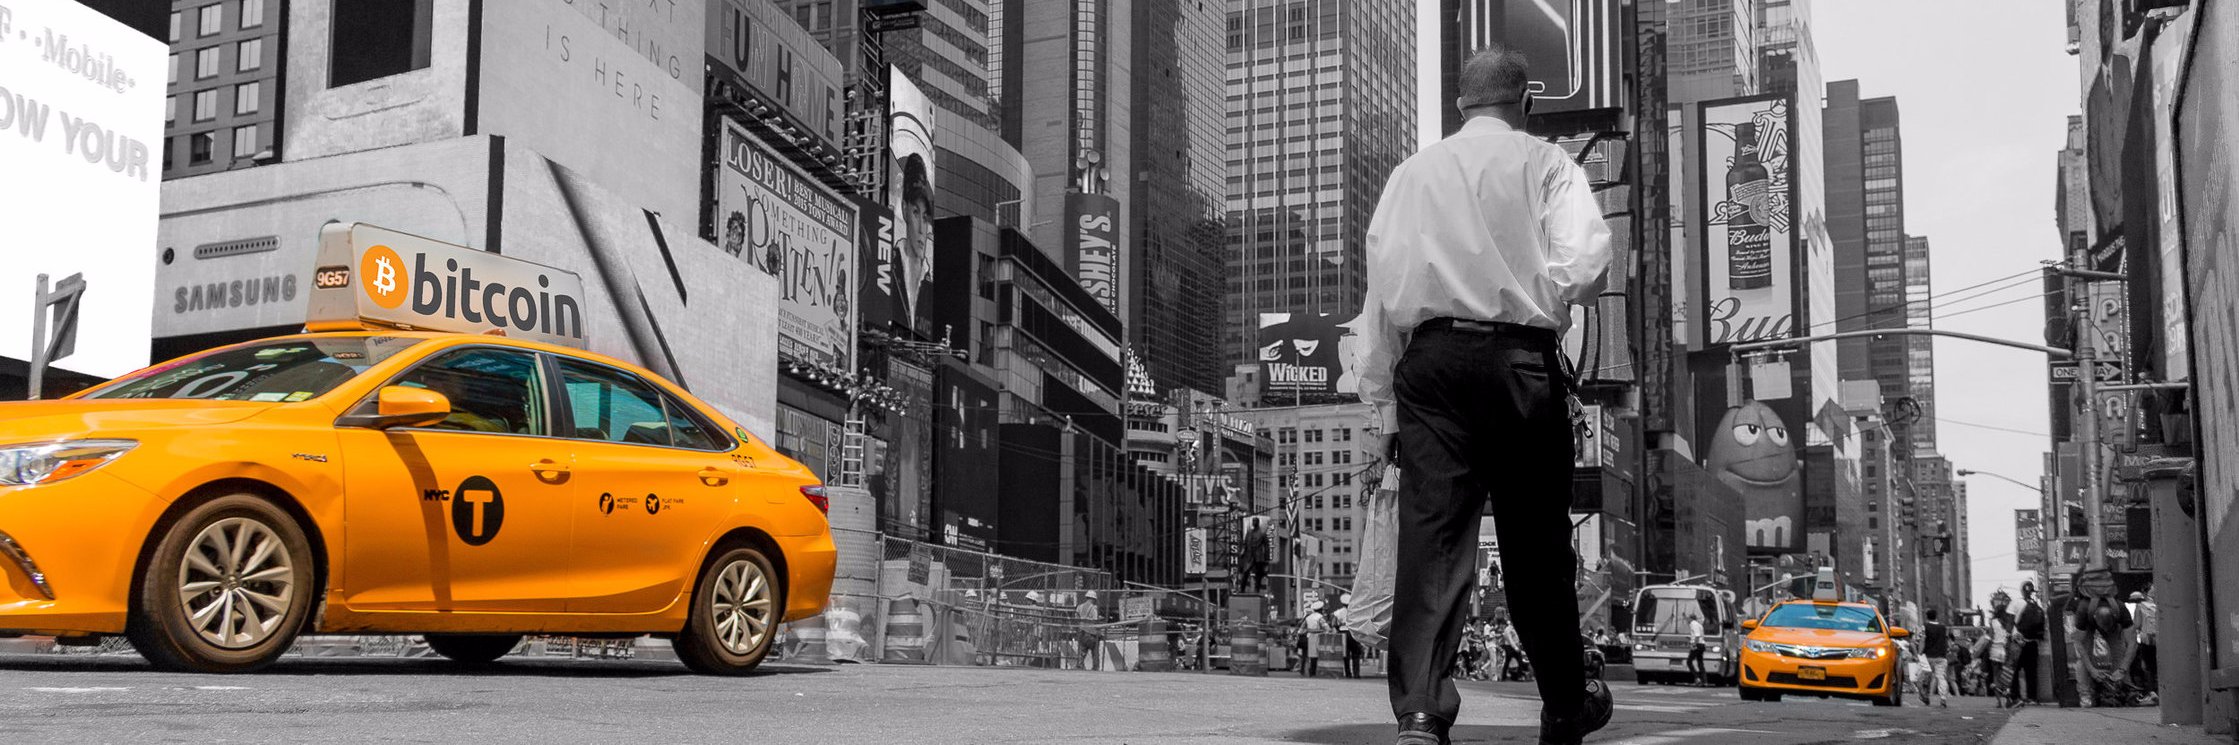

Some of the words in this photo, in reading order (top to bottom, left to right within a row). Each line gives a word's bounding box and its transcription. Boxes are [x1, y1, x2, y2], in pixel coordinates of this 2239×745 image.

[546, 24, 571, 62] IS
[594, 57, 660, 121] HERE
[600, 3, 681, 80] THING
[718, 2, 769, 89] FUN
[775, 43, 836, 142] HOME
[60, 110, 149, 182] YOUR
[727, 134, 792, 201] LOSER!
[753, 184, 828, 245] SOMETHING
[793, 193, 808, 211] 2015
[807, 202, 826, 223] TONY
[825, 214, 848, 236] AWARD
[794, 179, 814, 203] BEST
[316, 270, 350, 287] 9G57
[876, 216, 893, 297] NEW
[1079, 214, 1112, 309] SHEY'S
[174, 274, 297, 314] SAMSUNG
[412, 252, 582, 339] bitcoin
[2055, 367, 2078, 377] ONE
[423, 489, 450, 501] NYC
[462, 489, 494, 537] T
[1745, 515, 1792, 548] m
